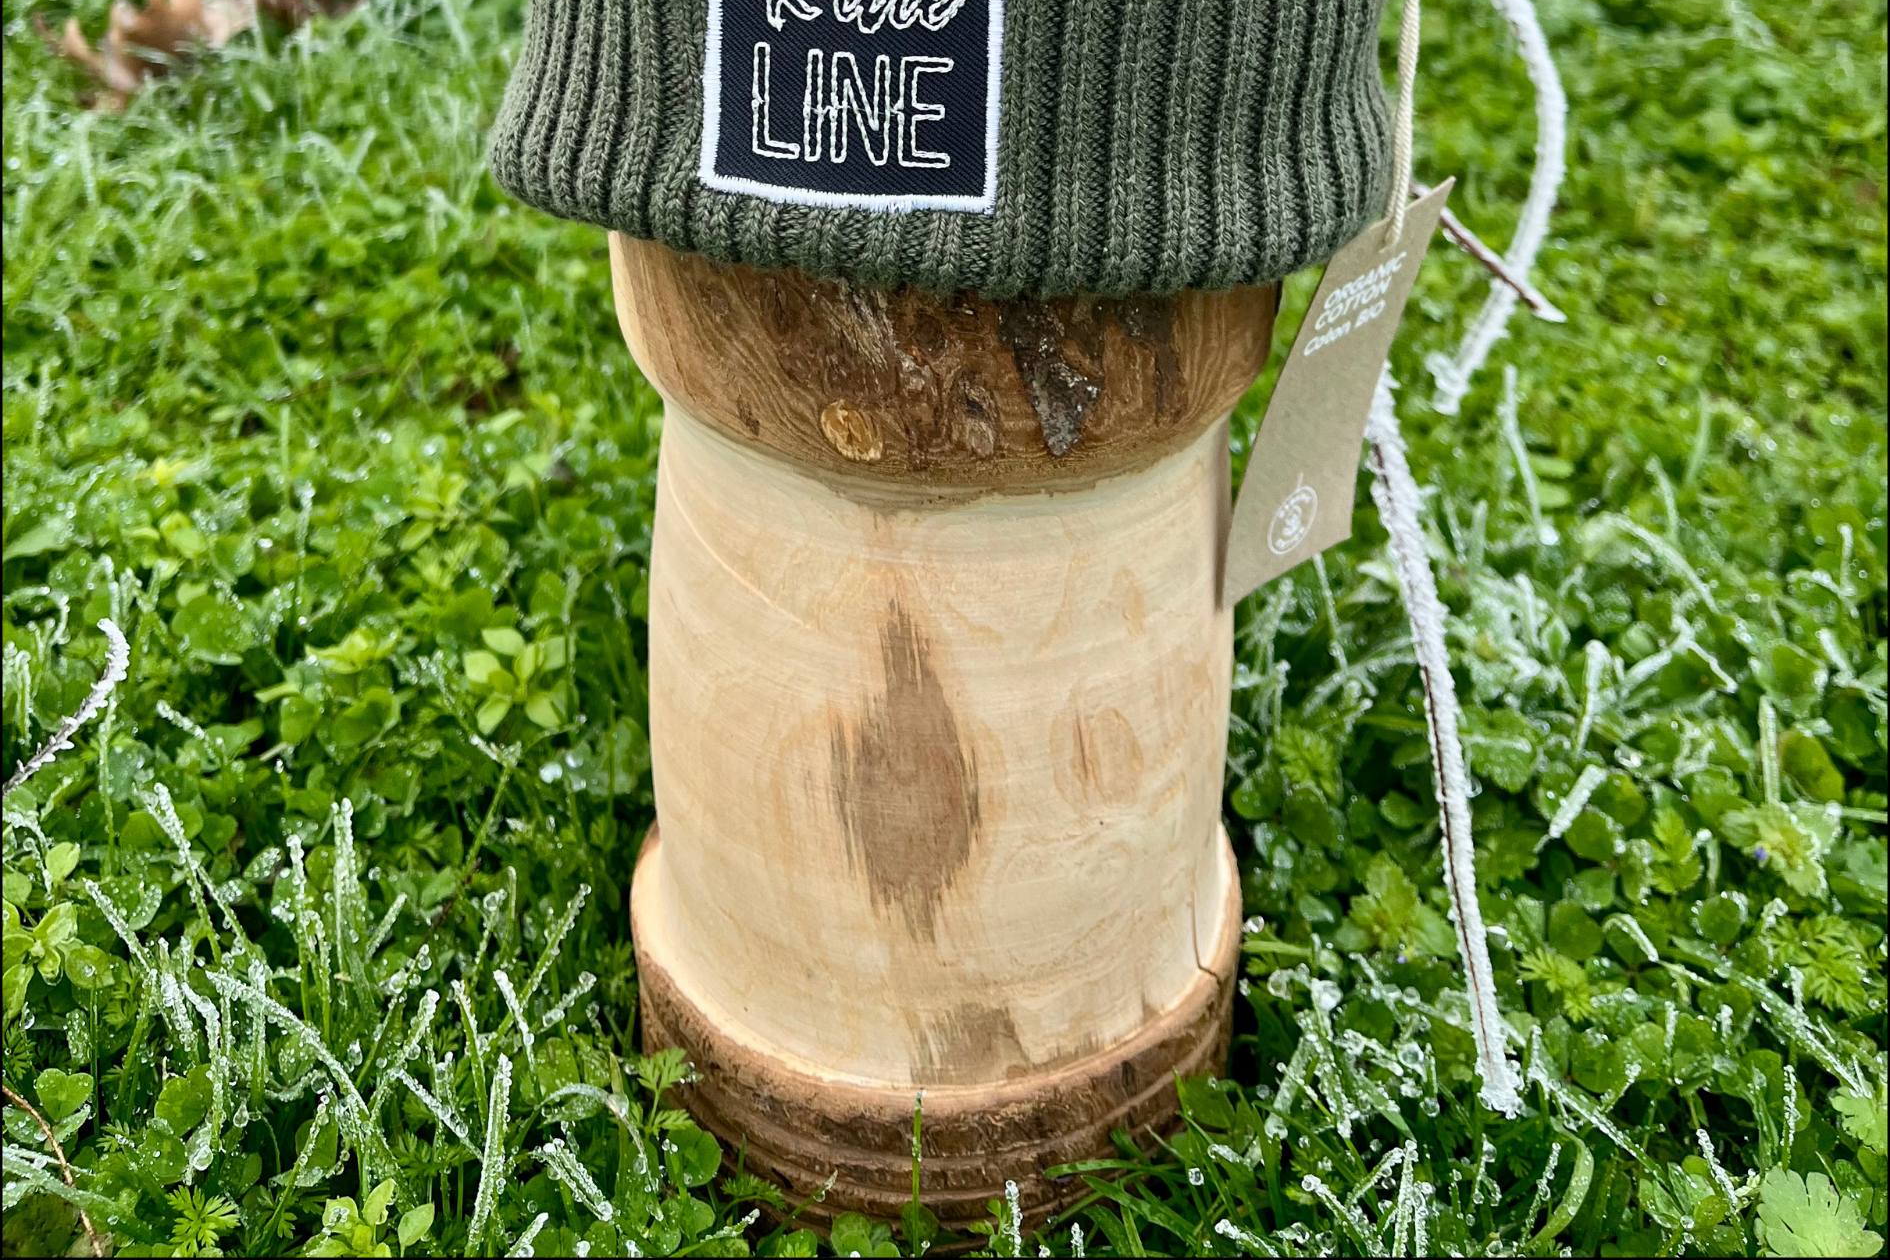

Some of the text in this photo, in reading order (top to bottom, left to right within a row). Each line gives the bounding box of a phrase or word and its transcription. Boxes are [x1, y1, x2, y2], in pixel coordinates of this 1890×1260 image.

[751, 41, 955, 168] LINE
[1314, 275, 1392, 331] COTTON
[1324, 251, 1407, 310] ORGANIC
